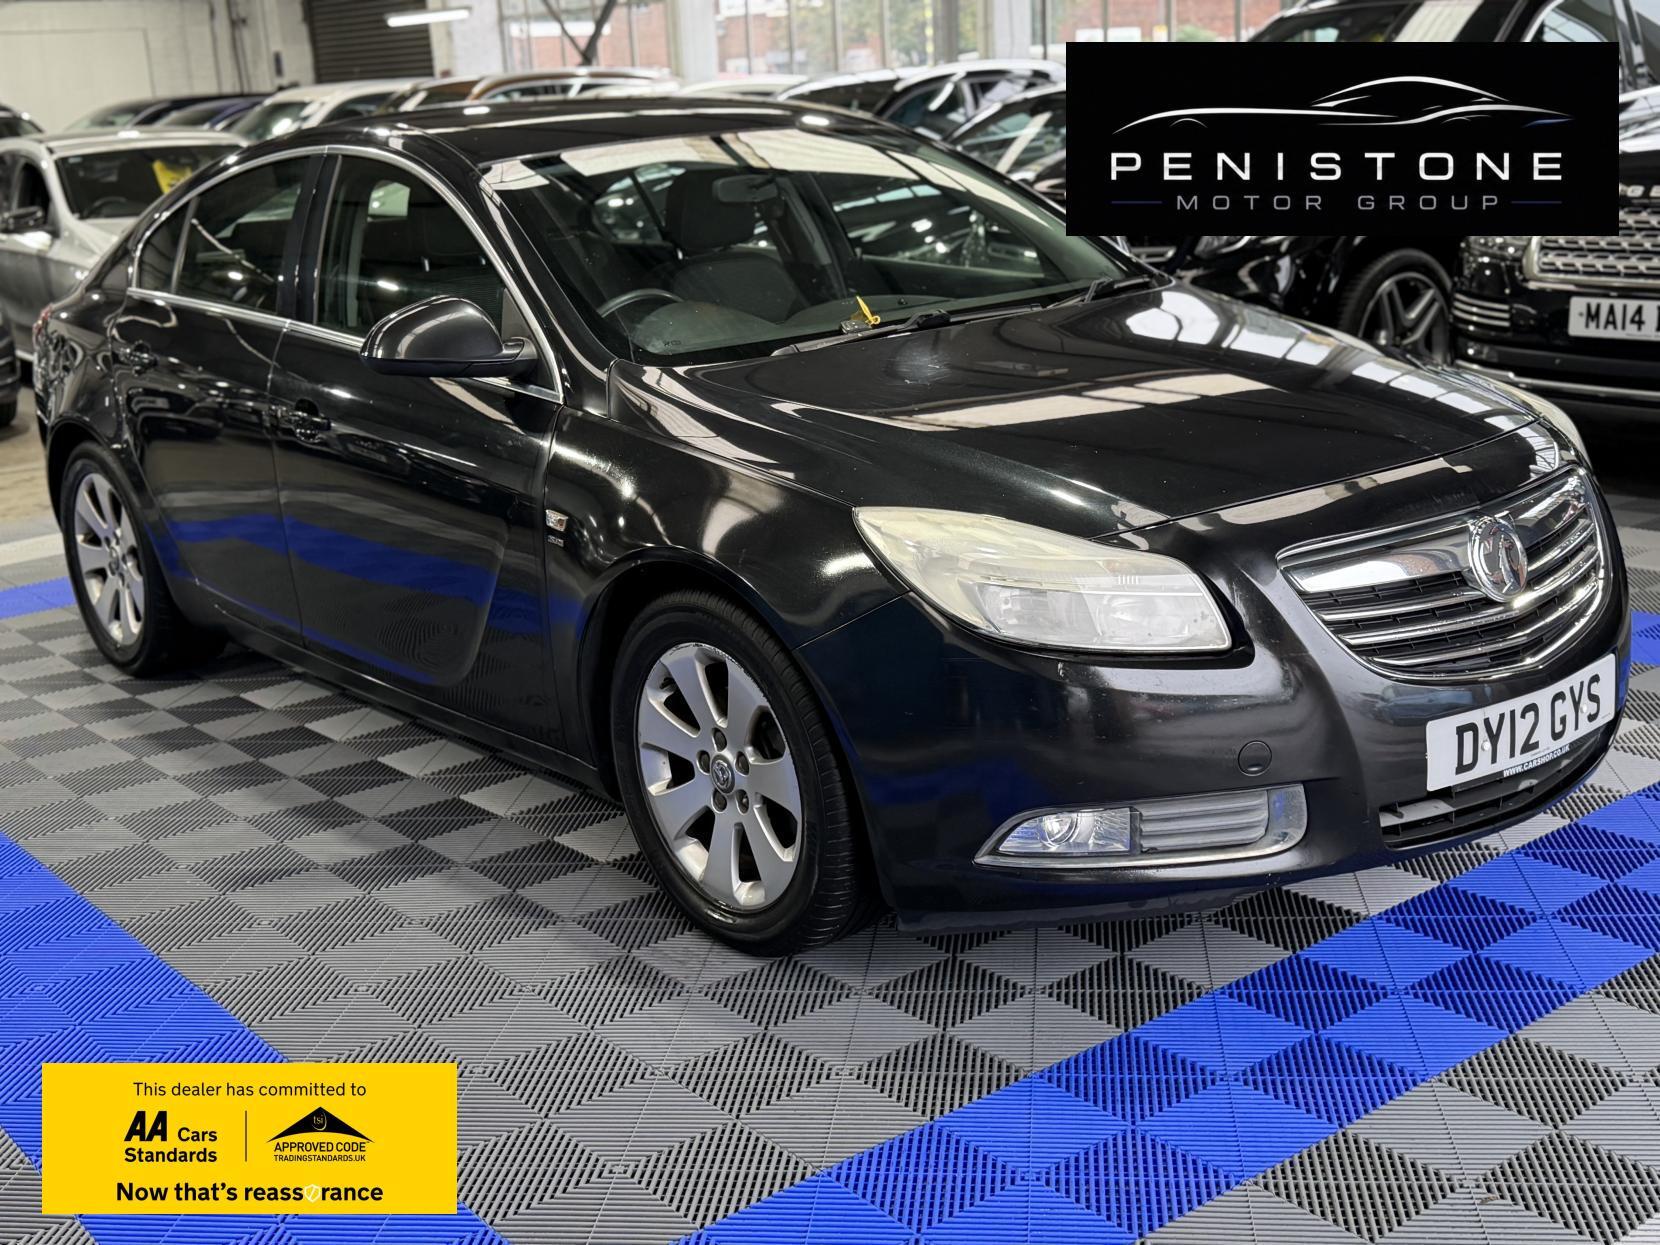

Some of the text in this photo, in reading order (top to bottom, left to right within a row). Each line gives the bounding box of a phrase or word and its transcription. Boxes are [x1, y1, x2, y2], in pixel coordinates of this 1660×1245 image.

[1585, 302, 1646, 332] MA14
[1455, 673, 1601, 776] DY12 GYS
